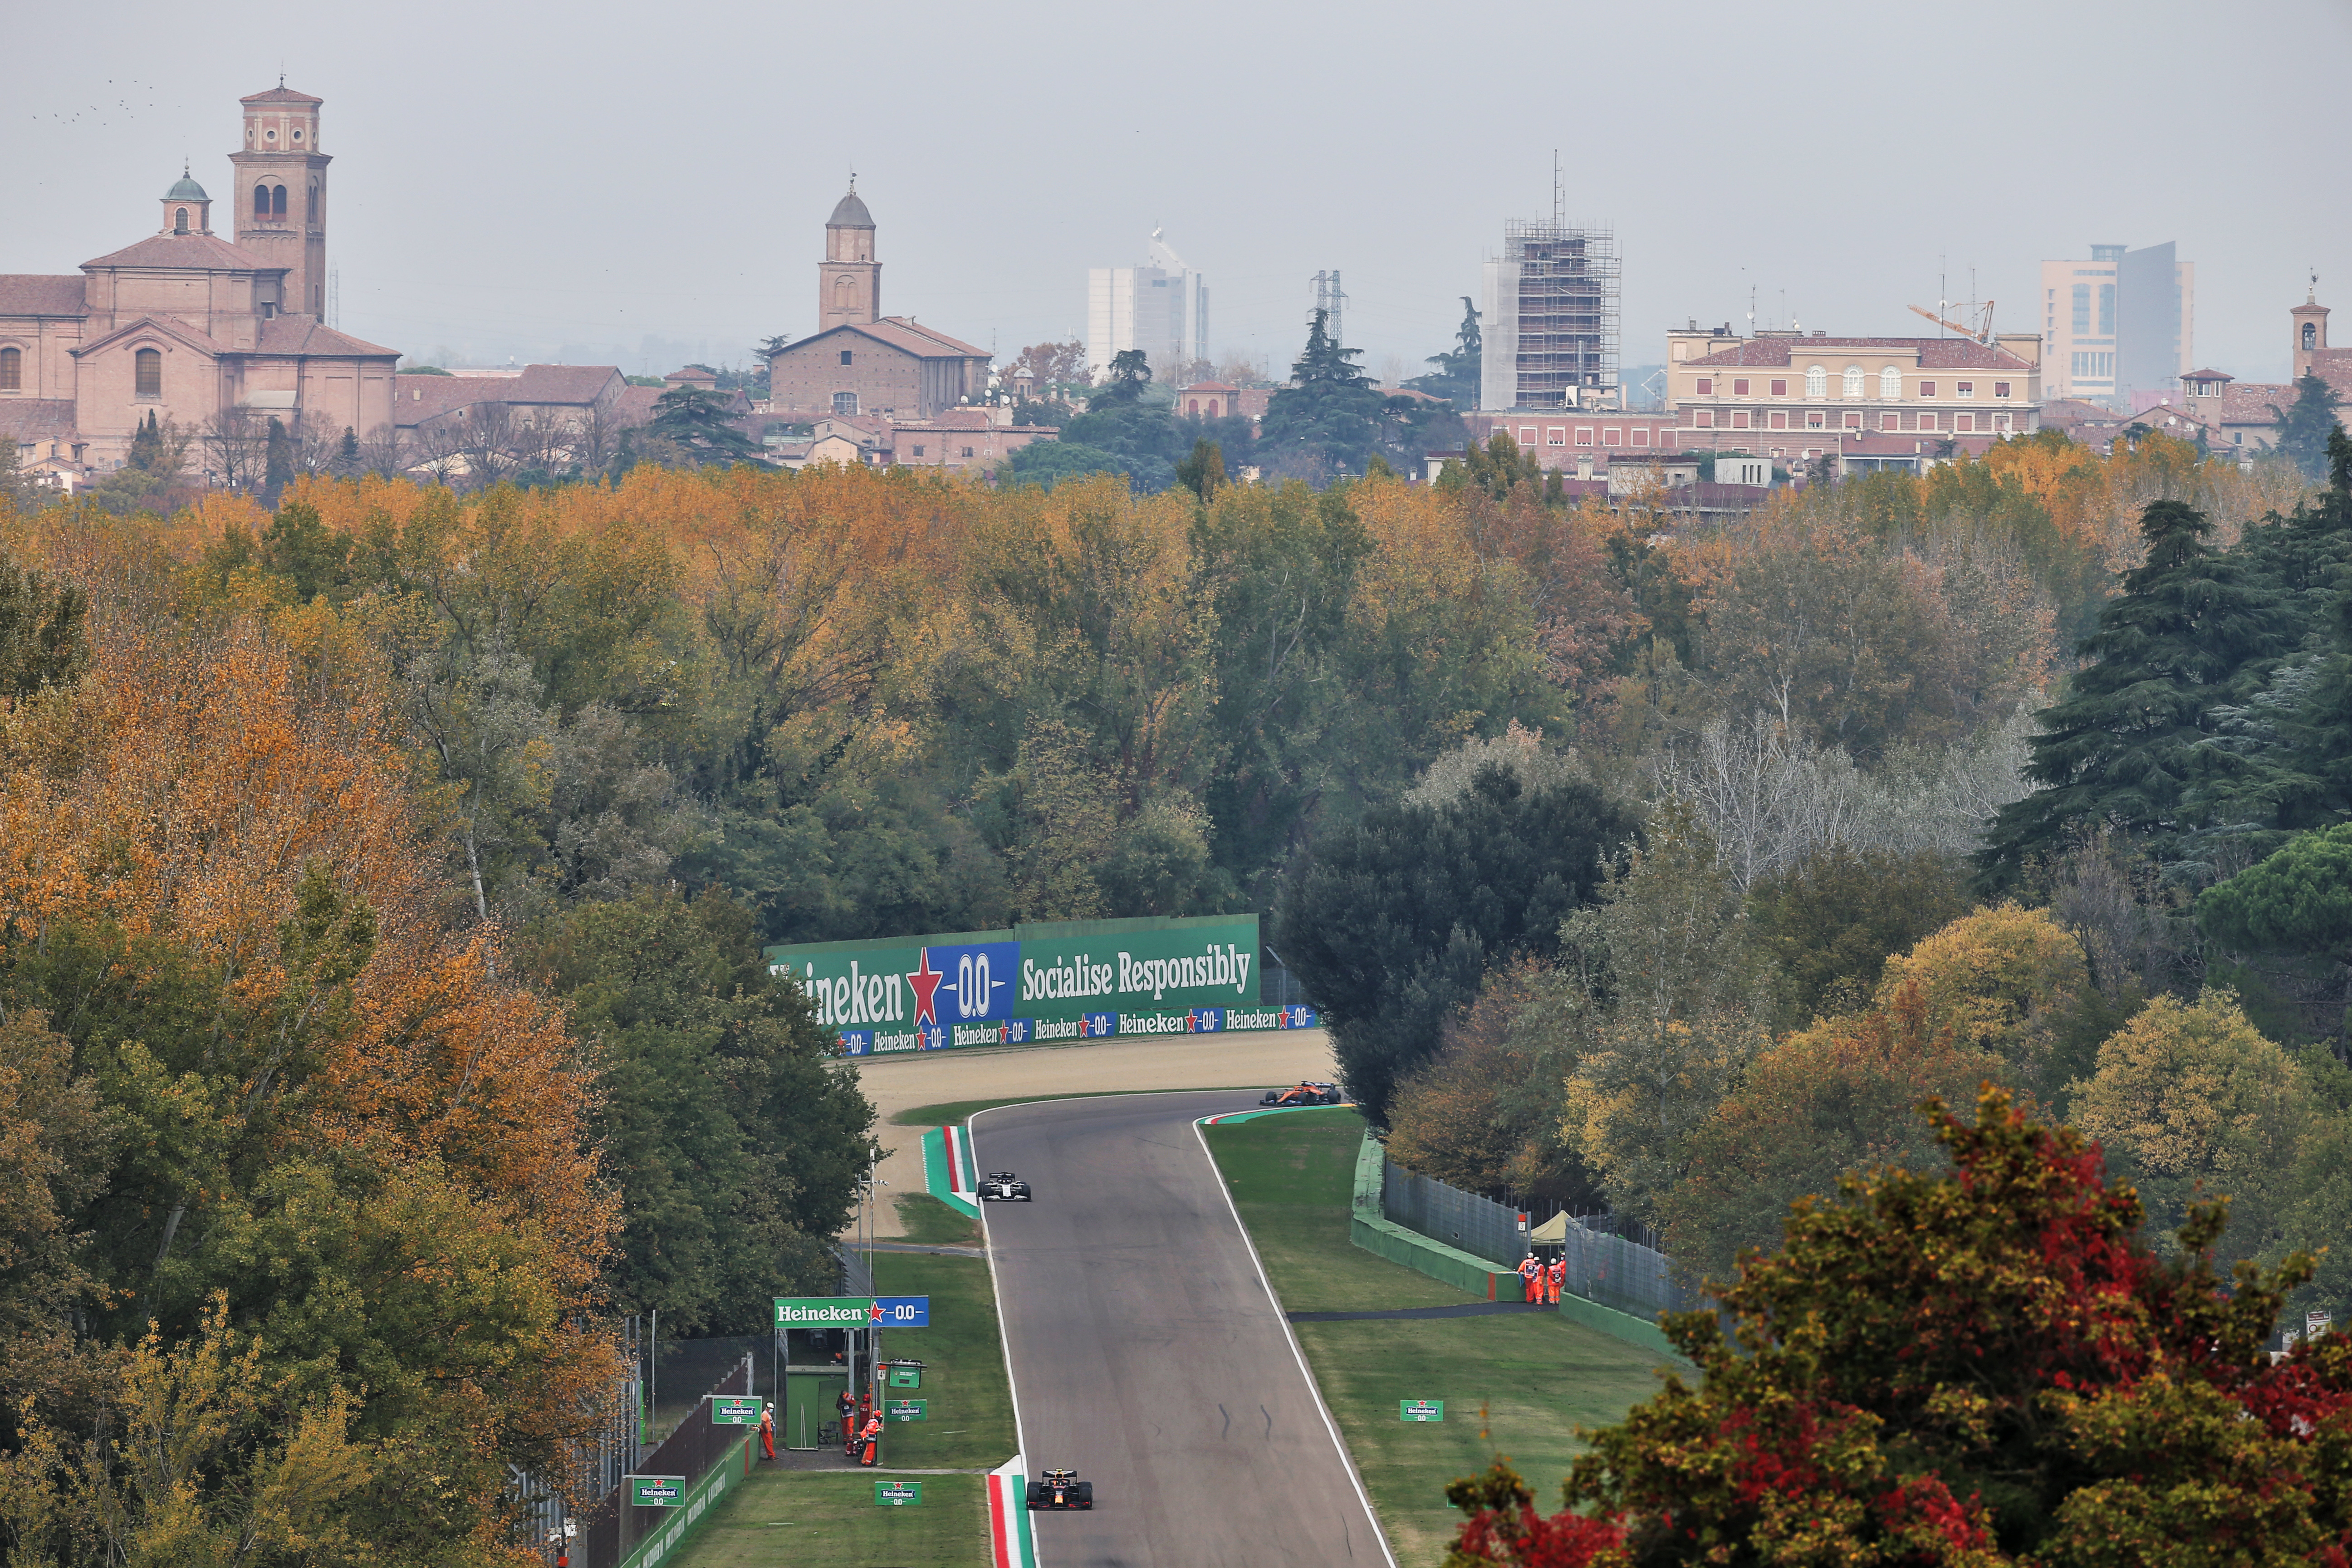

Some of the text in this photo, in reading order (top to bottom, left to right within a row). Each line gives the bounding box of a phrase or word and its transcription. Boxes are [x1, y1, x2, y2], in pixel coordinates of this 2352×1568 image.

[1023, 943, 1251, 1000] Socialise Responsibly
[959, 953, 990, 1019] 0.0
[1035, 1015, 1106, 1039] Heineken 0.0
[1119, 1011, 1214, 1034] Heineken 0.0
[1226, 1007, 1306, 1030] Heineken 0.0
[851, 1034, 862, 1054] 0.0
[873, 1027, 941, 1051] Heineken 0.0
[954, 1022, 1023, 1046] Heineken 0.0
[778, 1305, 915, 1321] Heineken 0.0
